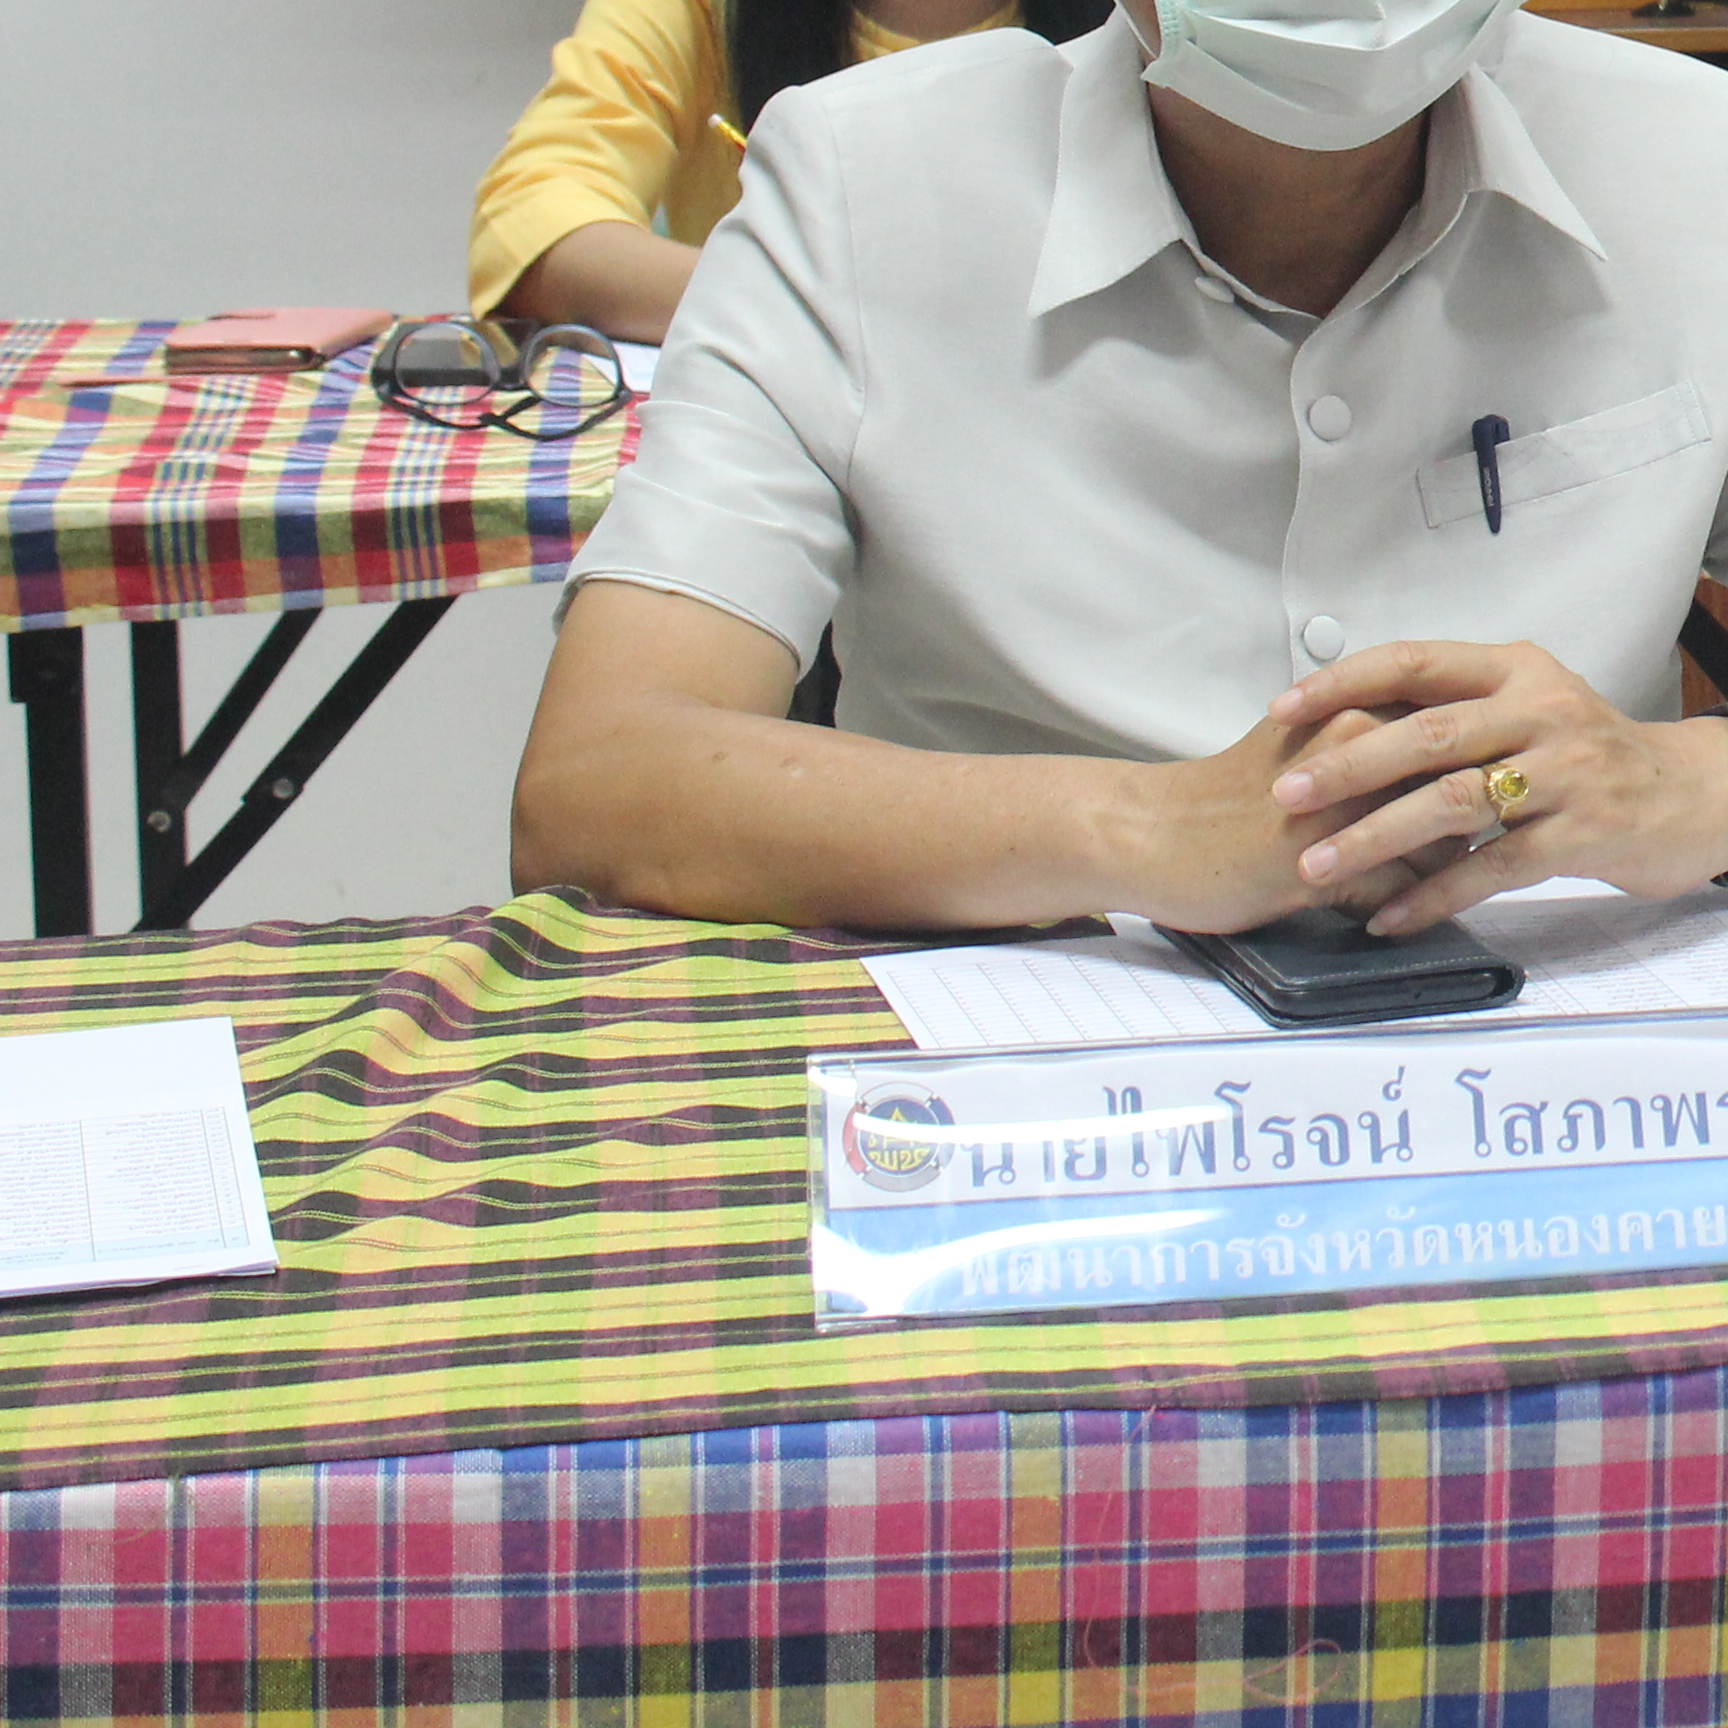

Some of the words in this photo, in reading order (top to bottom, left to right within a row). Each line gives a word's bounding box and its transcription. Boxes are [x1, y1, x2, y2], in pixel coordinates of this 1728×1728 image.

[958, 1202, 1728, 1297] พฒนาการจังหวัดหนองคาย
